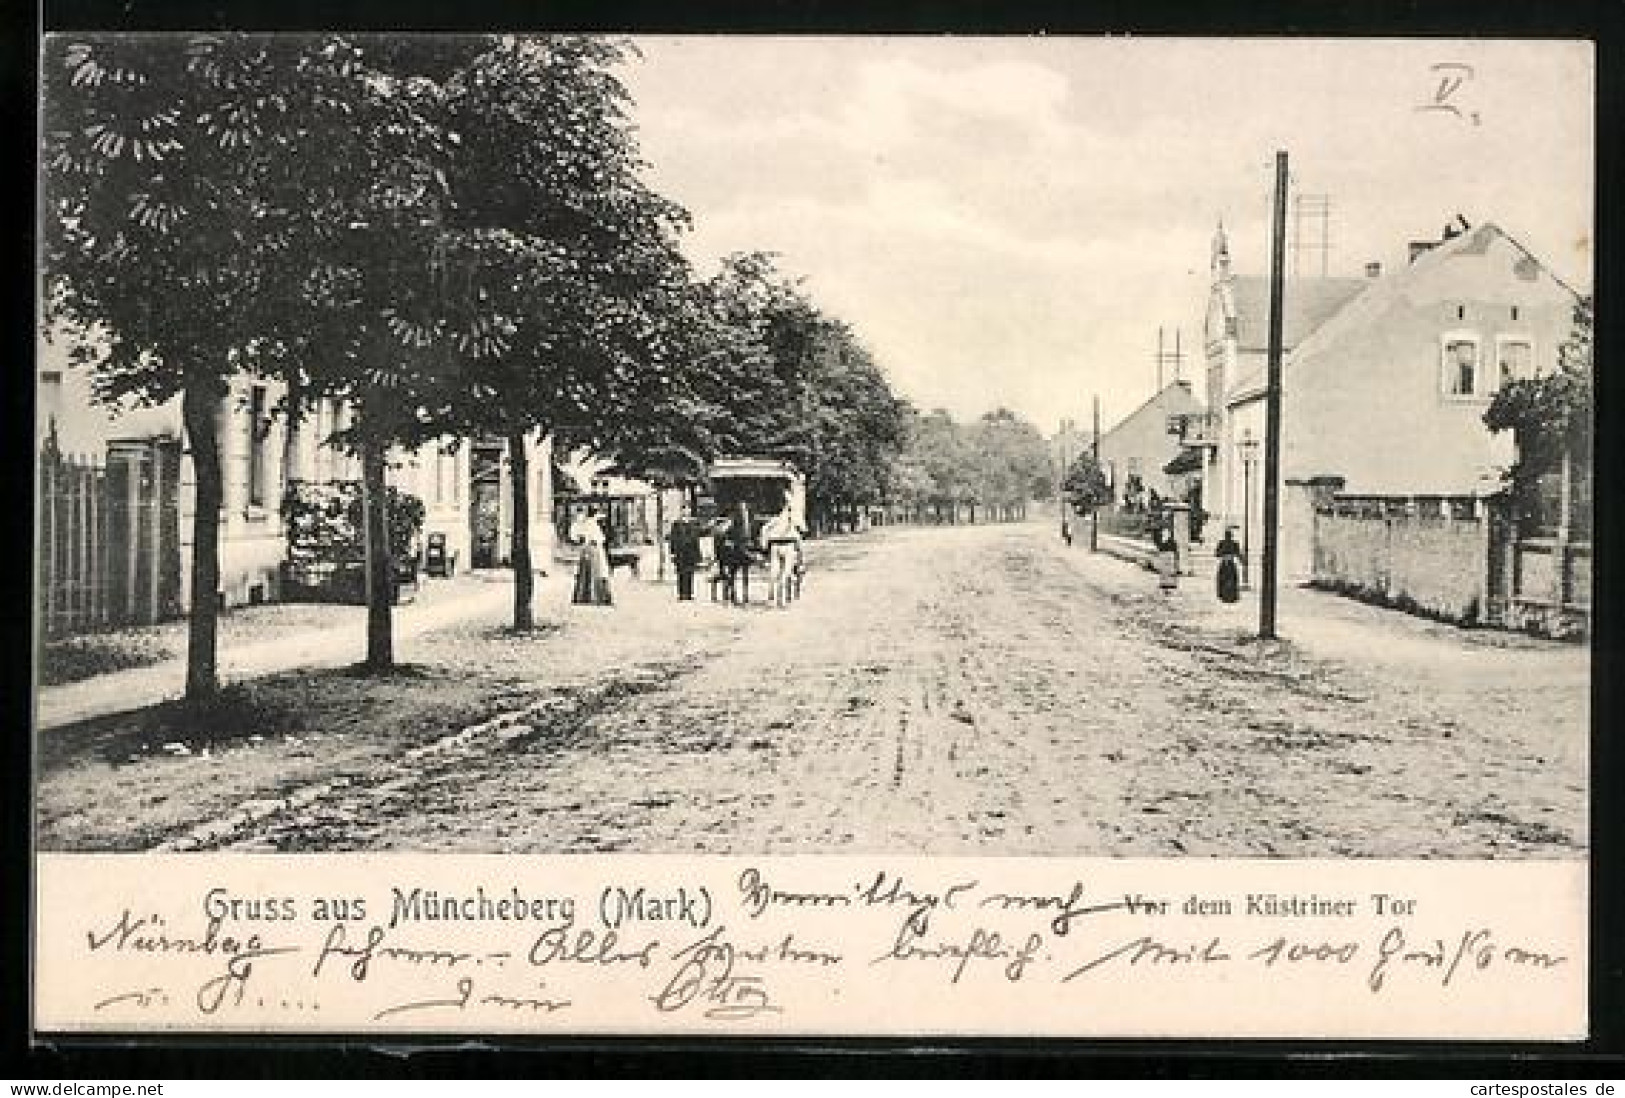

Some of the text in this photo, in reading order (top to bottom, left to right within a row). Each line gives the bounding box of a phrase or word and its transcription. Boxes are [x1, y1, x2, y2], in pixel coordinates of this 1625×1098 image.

[204, 886, 712, 929] Gruss aus Müncheberg (Mark)
[1182, 894, 1233, 917] dem
[1246, 893, 1358, 917] Küstriner
[1371, 894, 1418, 917] Tor
[1248, 937, 1359, 966] 1000
